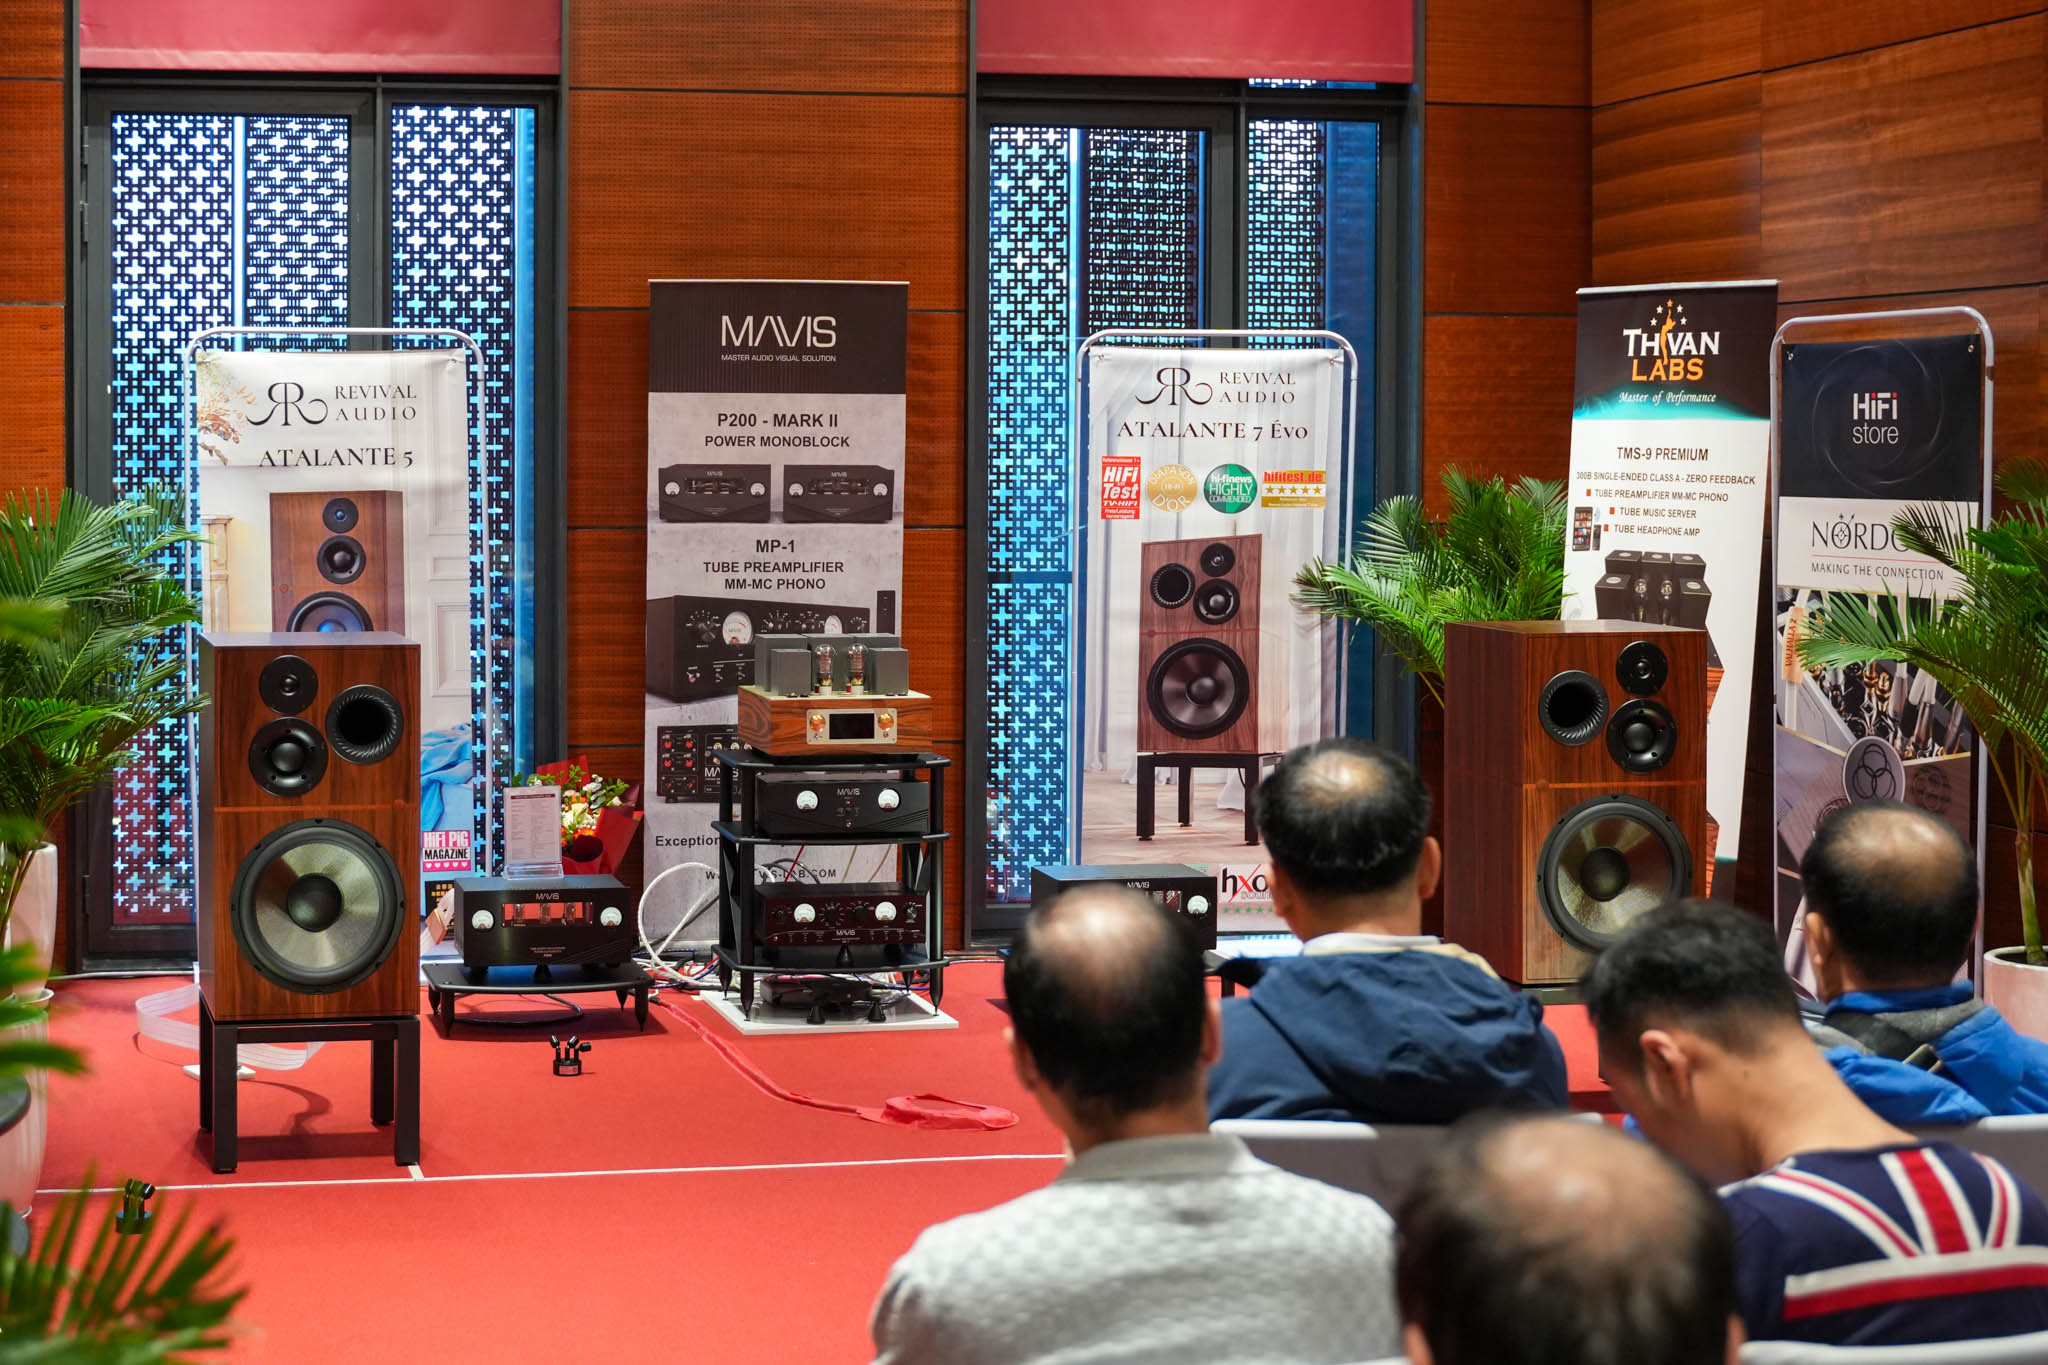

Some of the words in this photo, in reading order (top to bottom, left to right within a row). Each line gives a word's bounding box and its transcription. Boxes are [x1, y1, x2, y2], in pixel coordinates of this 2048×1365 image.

[721, 315, 837, 348] MAVIS
[1631, 357, 1705, 382] LABS
[1219, 371, 1296, 385] REVIVAL
[335, 385, 417, 400] REVIVAL
[1219, 391, 1296, 404] AUDIO
[1618, 391, 1649, 403] Master
[1652, 390, 1665, 406] of
[1665, 390, 1717, 407] Performance
[1853, 392, 1898, 420] HiFi
[335, 406, 417, 421] AUDIO
[717, 413, 757, 427] P200
[773, 413, 824, 428] MARK
[829, 414, 838, 427] II
[1117, 421, 1246, 439] ATALANTE
[1253, 426, 1264, 442] 7
[1853, 422, 1899, 444] store
[705, 435, 756, 447] POWER
[760, 435, 850, 447] MONOBLOCK
[259, 447, 396, 468] ATALANTE
[403, 451, 414, 469] 5
[1616, 446, 1652, 461] TMS-9
[1655, 448, 1709, 462] PREMIUM
[1593, 471, 1648, 482] SINGLE-ENDED
[1649, 473, 1674, 483] CLASS
[1674, 474, 1681, 482] A
[1685, 474, 1708, 483] ZERO
[1709, 475, 1756, 485] FEEDBACK
[1103, 482, 1140, 500] Test
[1209, 483, 1253, 496] HIGHLY
[1595, 488, 1614, 498] TUBE
[1614, 489, 1670, 500] PREAMPLIFIER
[1671, 491, 1697, 501] MM-MC
[1698, 492, 1729, 502] PHONO
[1209, 495, 1252, 504] COMMENDED
[1619, 506, 1641, 516] TUBE
[1642, 508, 1666, 518] MUSIC
[1667, 509, 1697, 519] SERVER
[1614, 524, 1636, 534] TUBE
[1637, 526, 1682, 536] HEADPHONE
[1683, 527, 1701, 537] AMP
[756, 539, 795, 553] MP-1
[703, 561, 740, 573] TUBE
[744, 561, 844, 573] PREAMPLIFIER
[1811, 562, 1850, 575] MAKING
[1853, 564, 1872, 577] THE
[1875, 566, 1944, 581] CONNECTION
[724, 578, 773, 590] MM-MC
[777, 579, 826, 590] PHONO
[1784, 626, 1797, 667] VALHALLA
[1126, 881, 1150, 889] MAVIS
[535, 892, 560, 900] MAVIS
